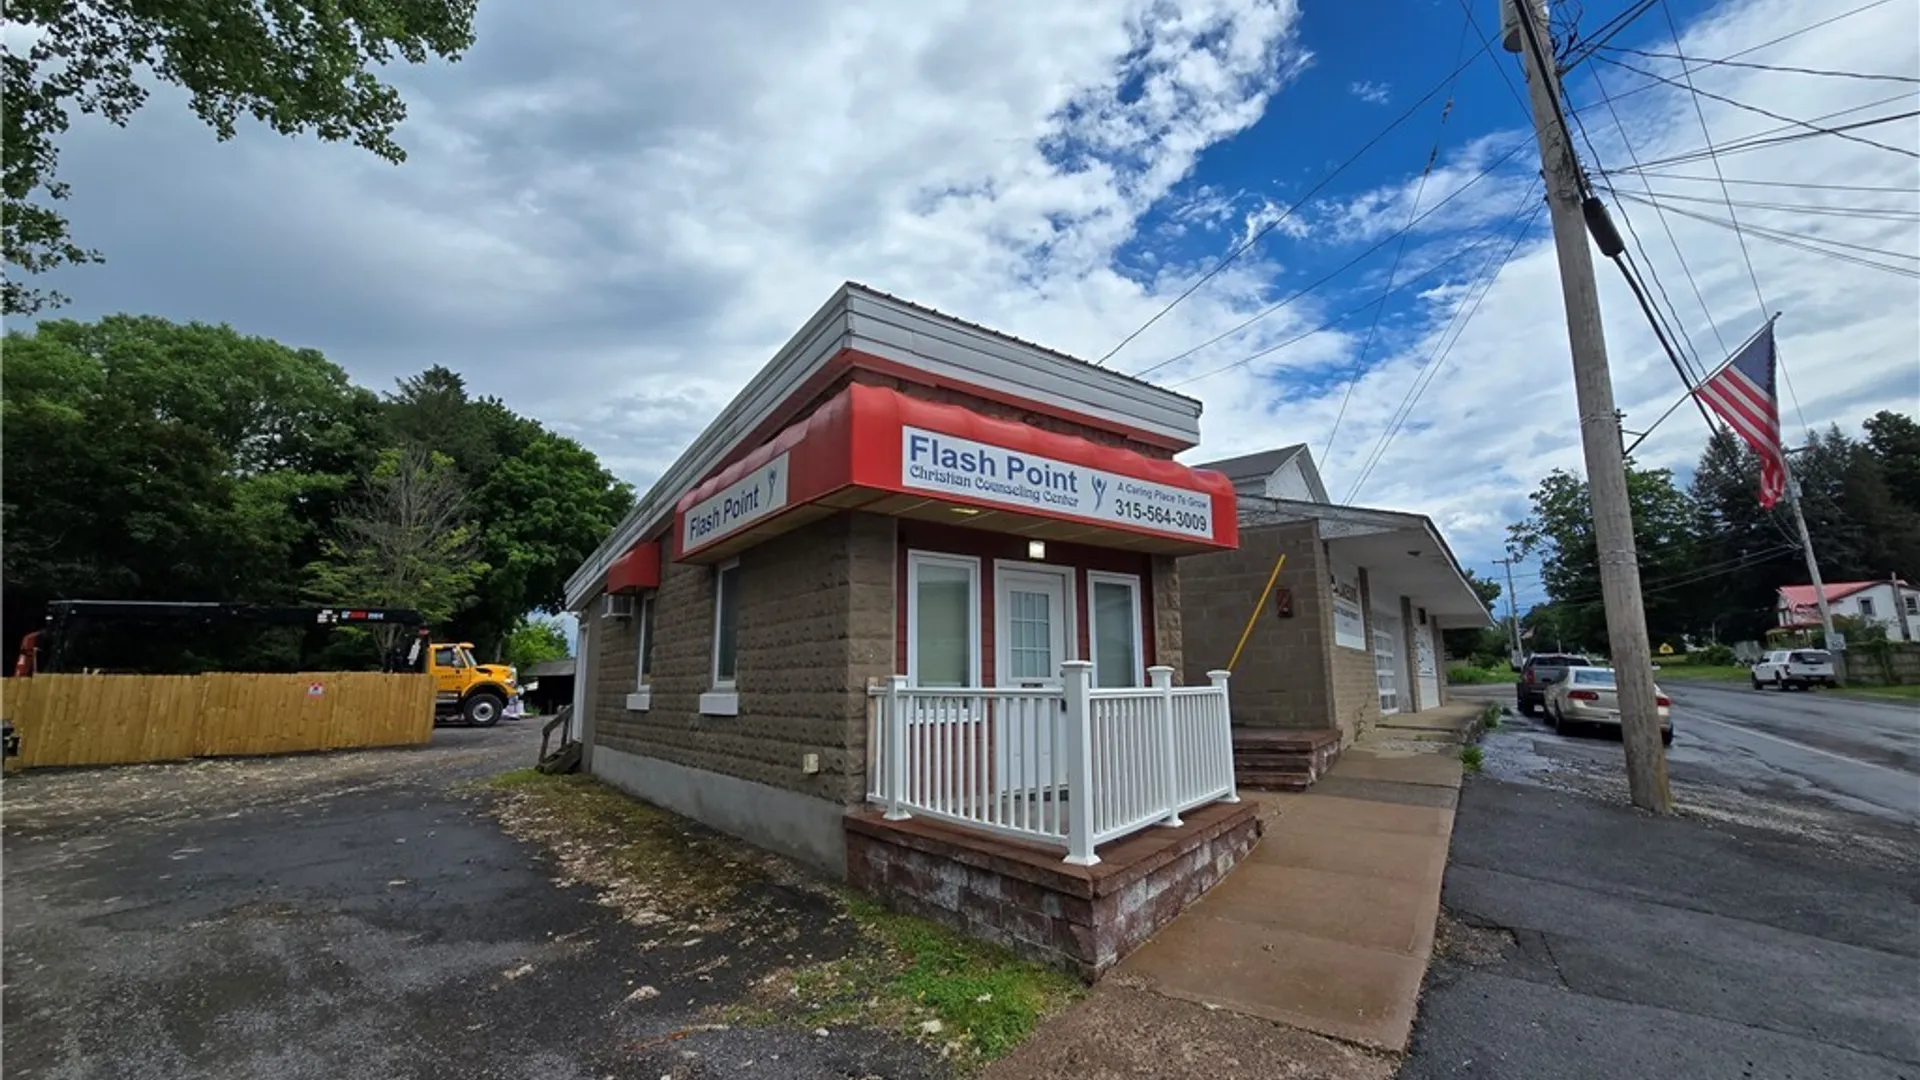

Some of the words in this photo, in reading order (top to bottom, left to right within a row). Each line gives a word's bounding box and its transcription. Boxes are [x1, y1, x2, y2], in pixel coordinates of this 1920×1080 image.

[910, 434, 996, 477] Flash
[1006, 455, 1078, 493] Point
[909, 464, 971, 488] Christian
[974, 476, 1041, 502] Counseling
[1042, 491, 1079, 507] Center
[1117, 482, 1124, 492] A
[1125, 484, 1152, 500] Caring
[1154, 490, 1176, 503] Place
[690, 507, 720, 541] Flash
[723, 484, 759, 524] Point
[1115, 498, 1207, 532] 315-564-3009
